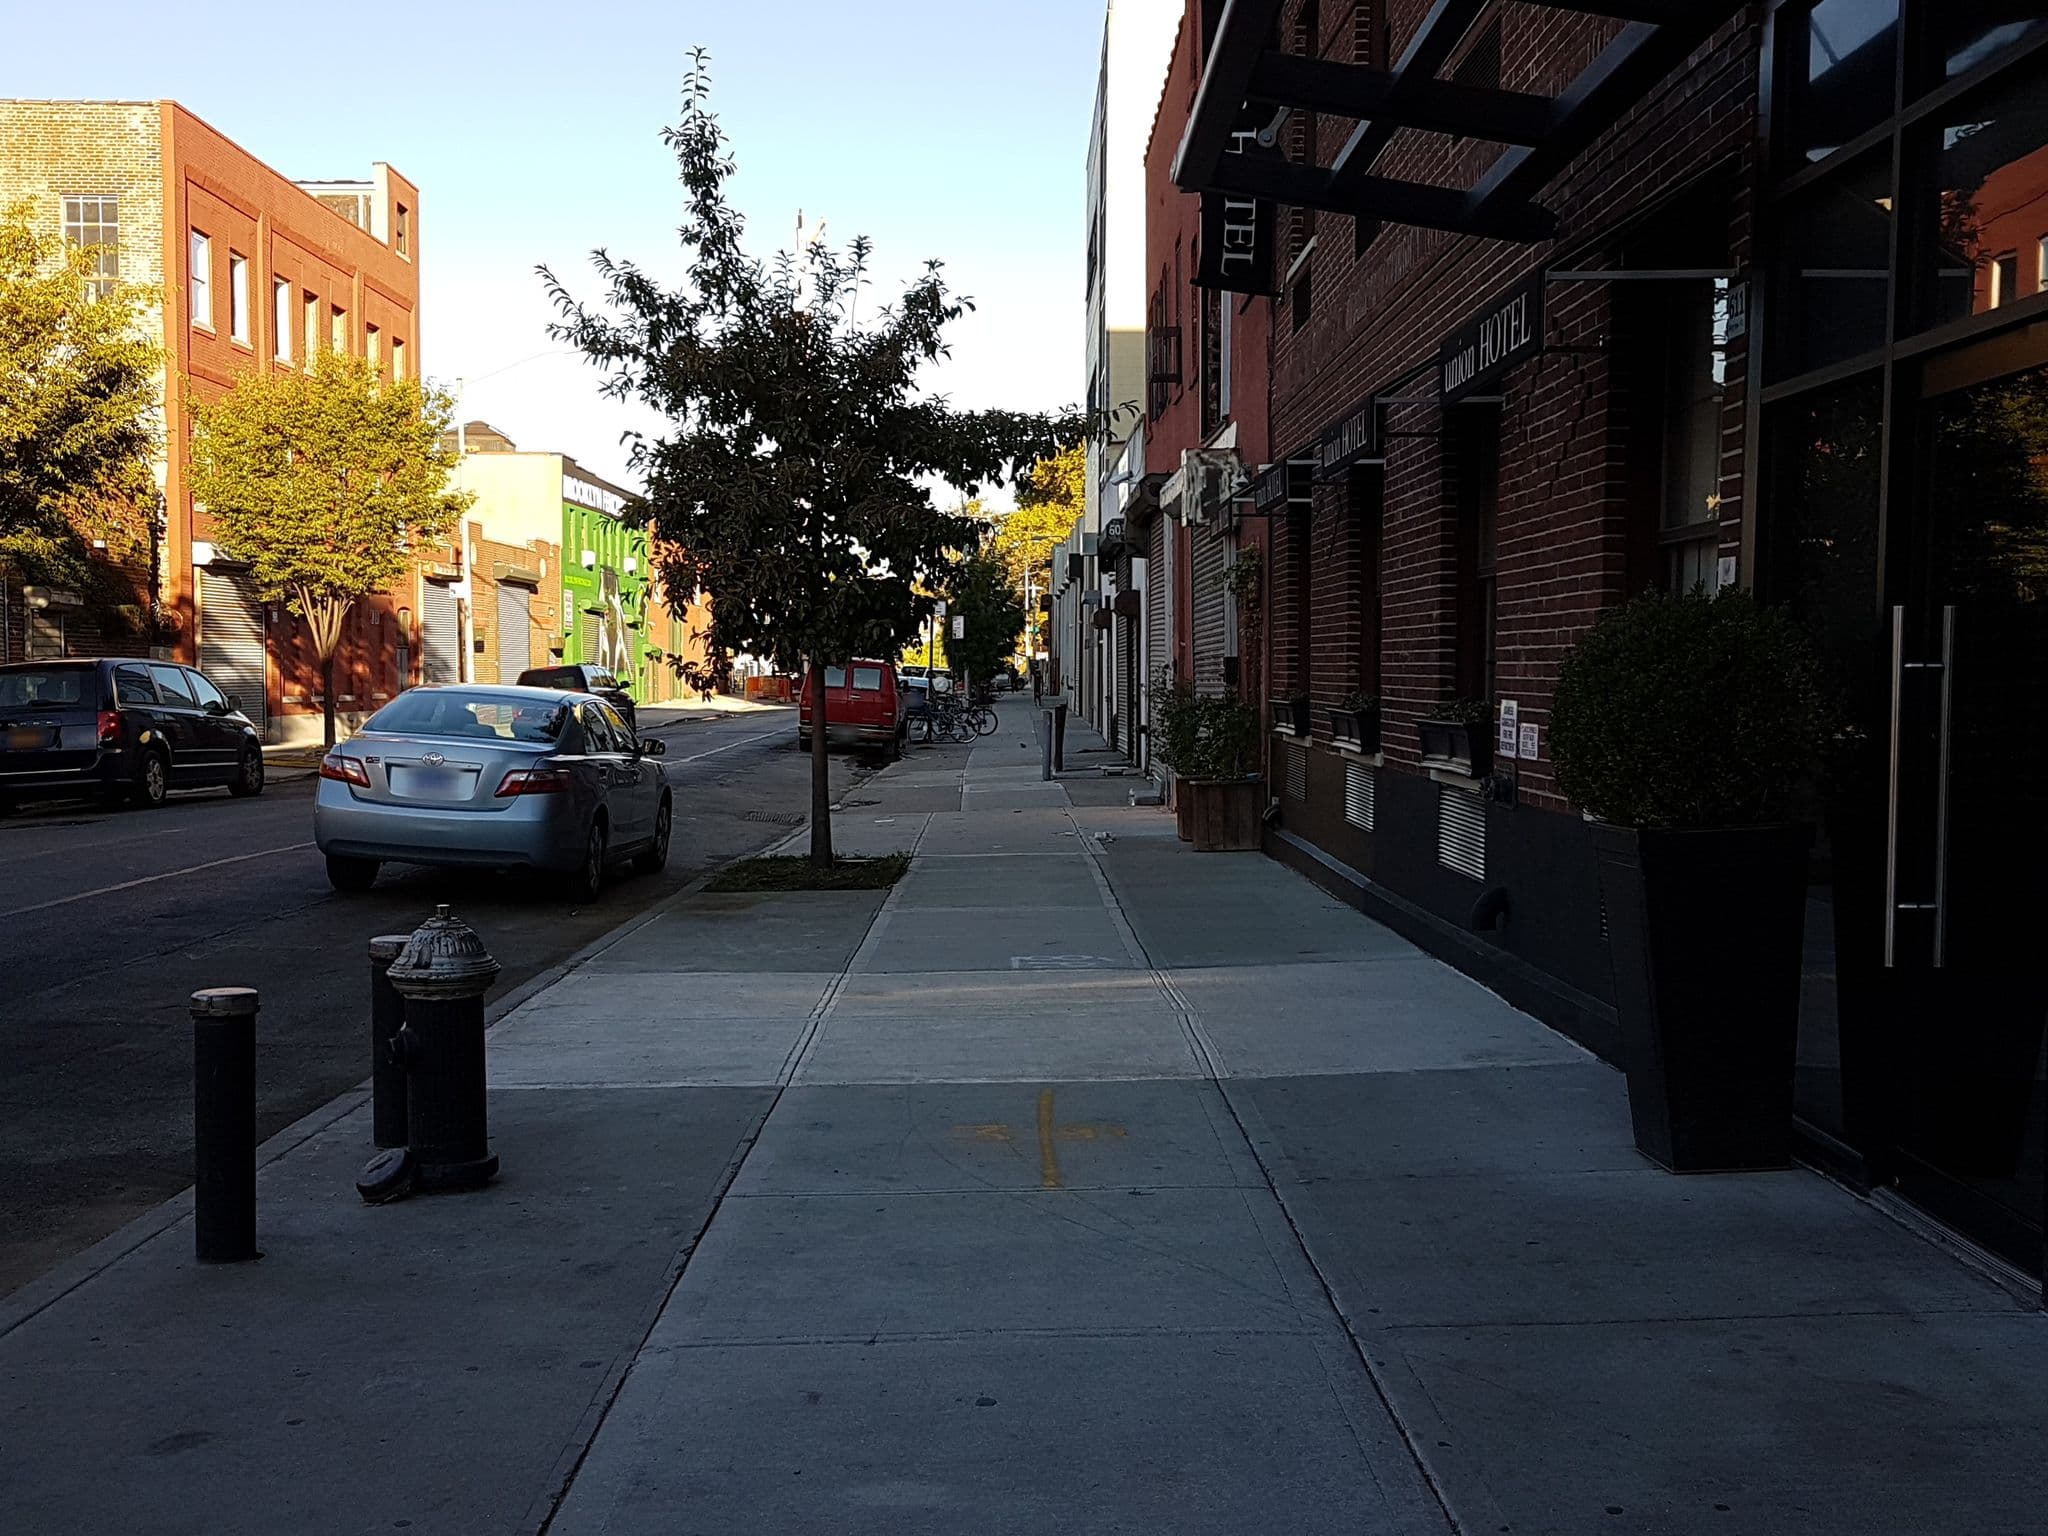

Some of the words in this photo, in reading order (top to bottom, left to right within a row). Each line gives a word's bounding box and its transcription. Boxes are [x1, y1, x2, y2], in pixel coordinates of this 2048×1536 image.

[1220, 126, 1257, 277] HTEL
[1444, 336, 1476, 393] union
[1478, 291, 1533, 372] HOTEL
[1729, 290, 1744, 320] 611
[1341, 409, 1368, 458] HOTEL
